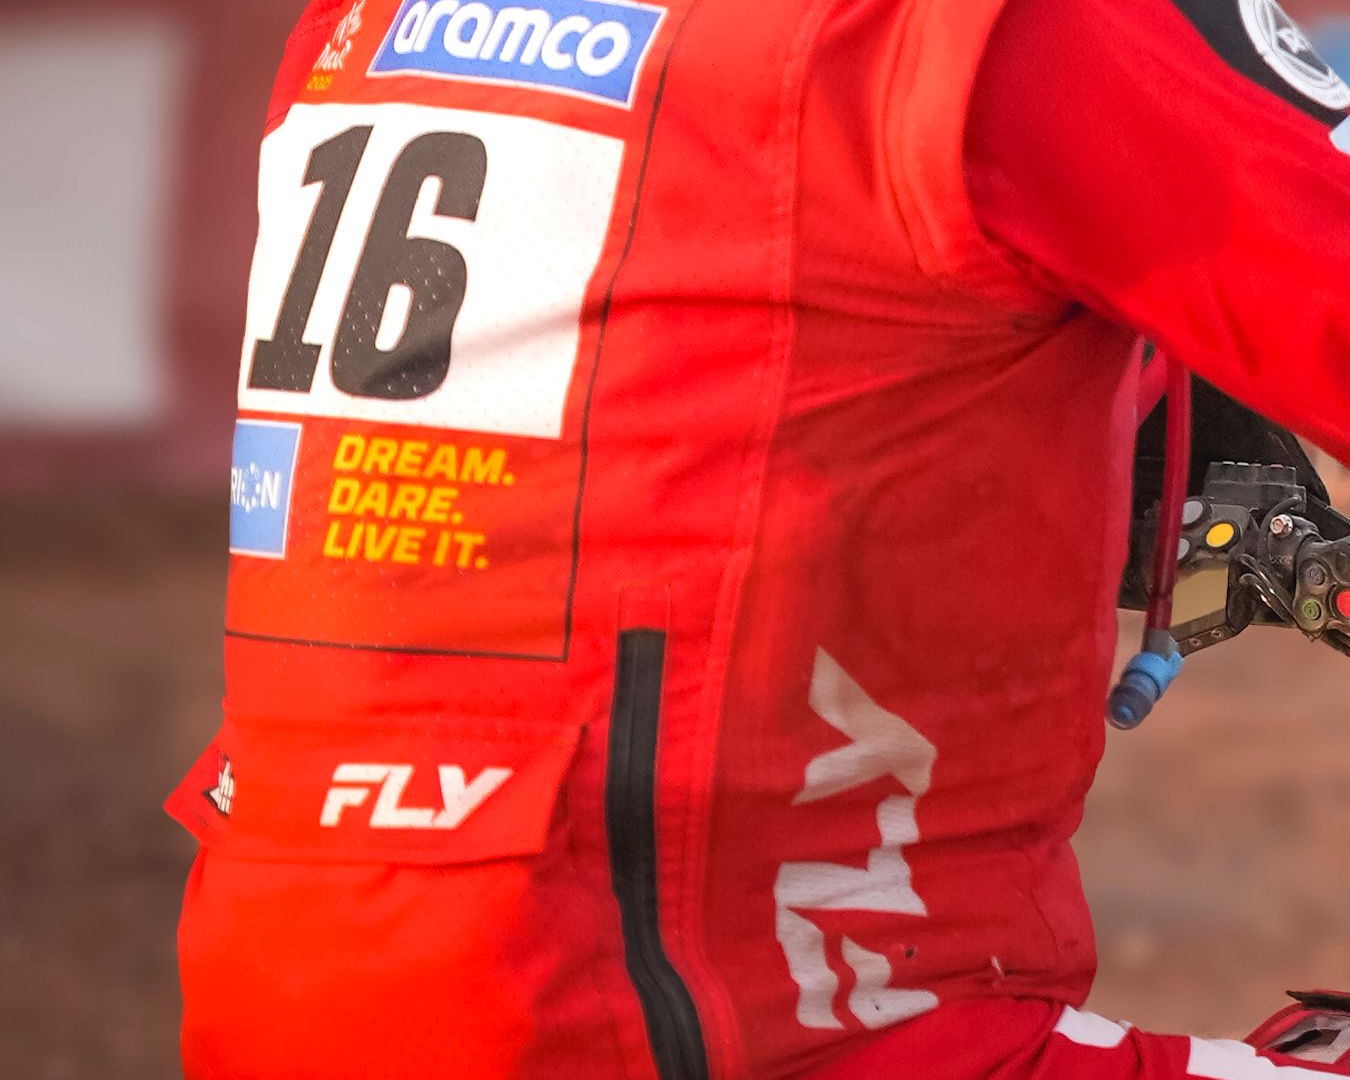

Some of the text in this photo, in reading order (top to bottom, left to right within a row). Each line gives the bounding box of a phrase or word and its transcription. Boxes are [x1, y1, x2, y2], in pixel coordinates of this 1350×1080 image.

[247, 123, 488, 402] 16
[333, 434, 514, 485] DREAM.
[327, 478, 463, 524] DARE.
[323, 522, 489, 570] LIVE IT.
[320, 763, 513, 829] FLY
[774, 645, 939, 1030] FLY
